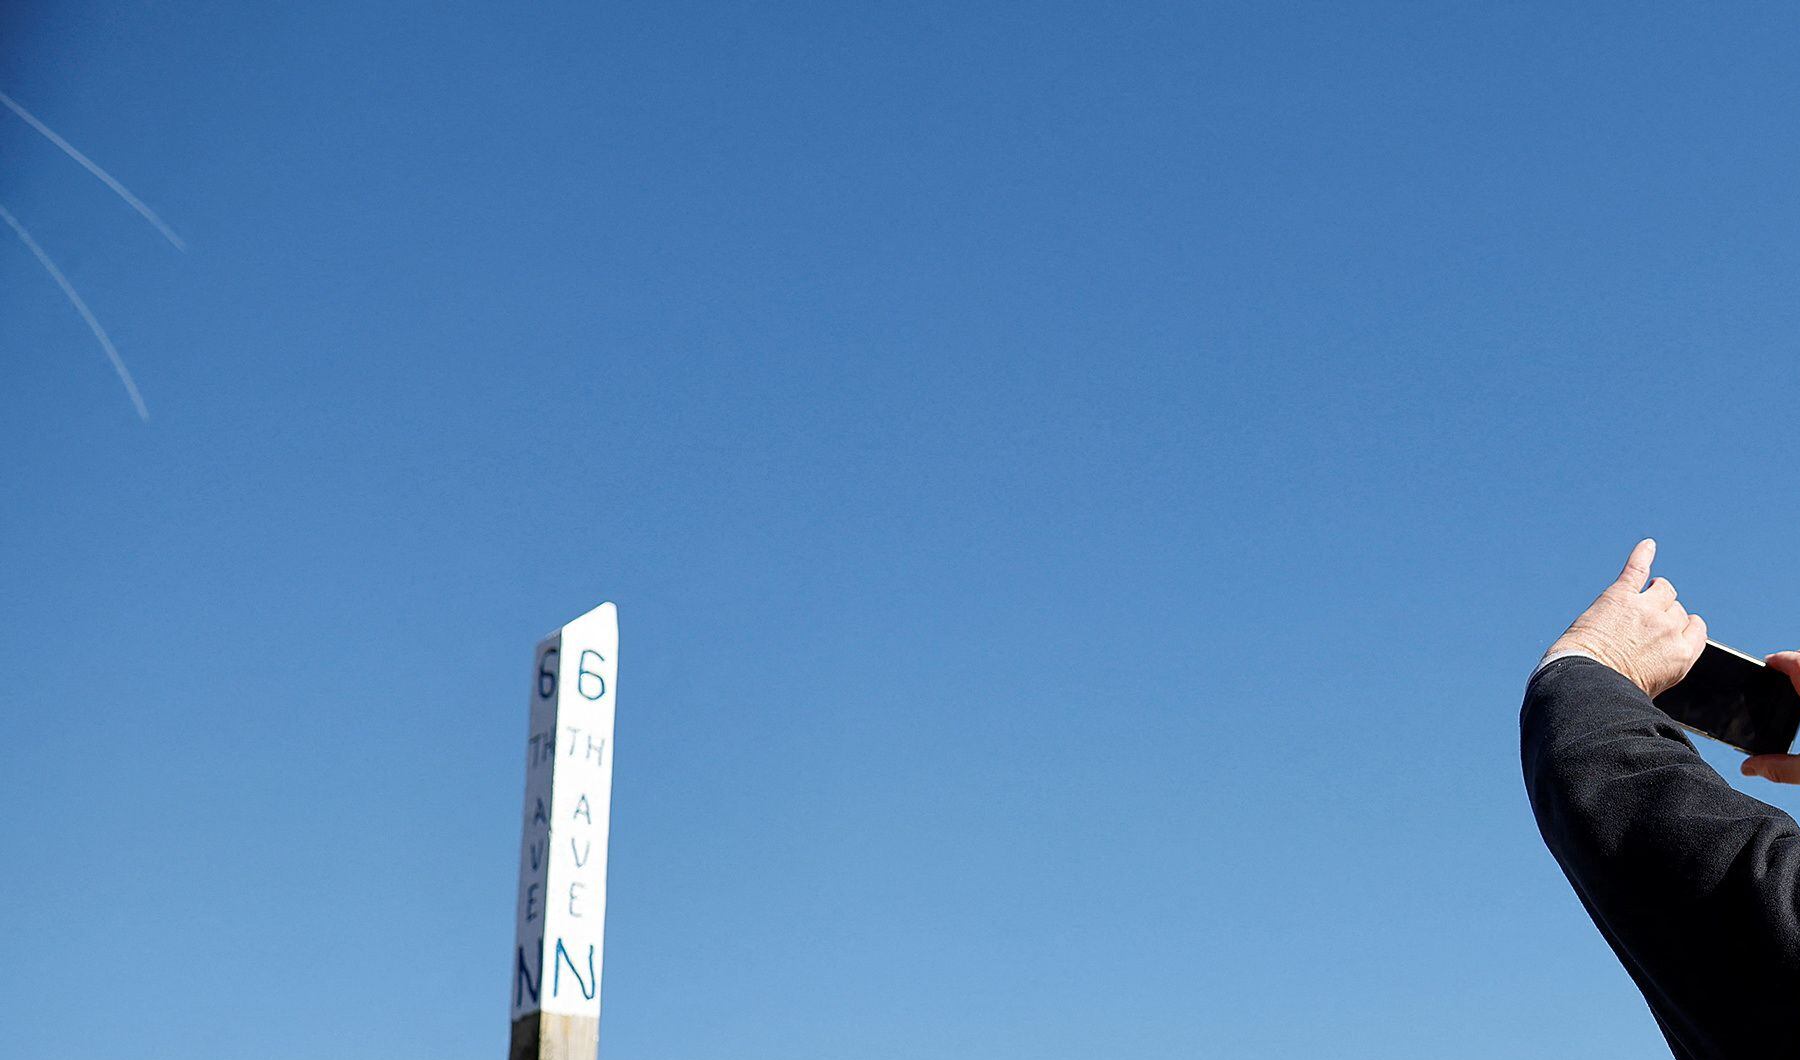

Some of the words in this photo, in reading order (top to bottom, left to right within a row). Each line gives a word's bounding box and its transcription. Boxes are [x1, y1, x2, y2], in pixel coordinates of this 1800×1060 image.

[526, 798, 548, 922] AVE
[570, 794, 592, 917] AVE
[515, 937, 544, 1007] N
[554, 938, 596, 1000] N
